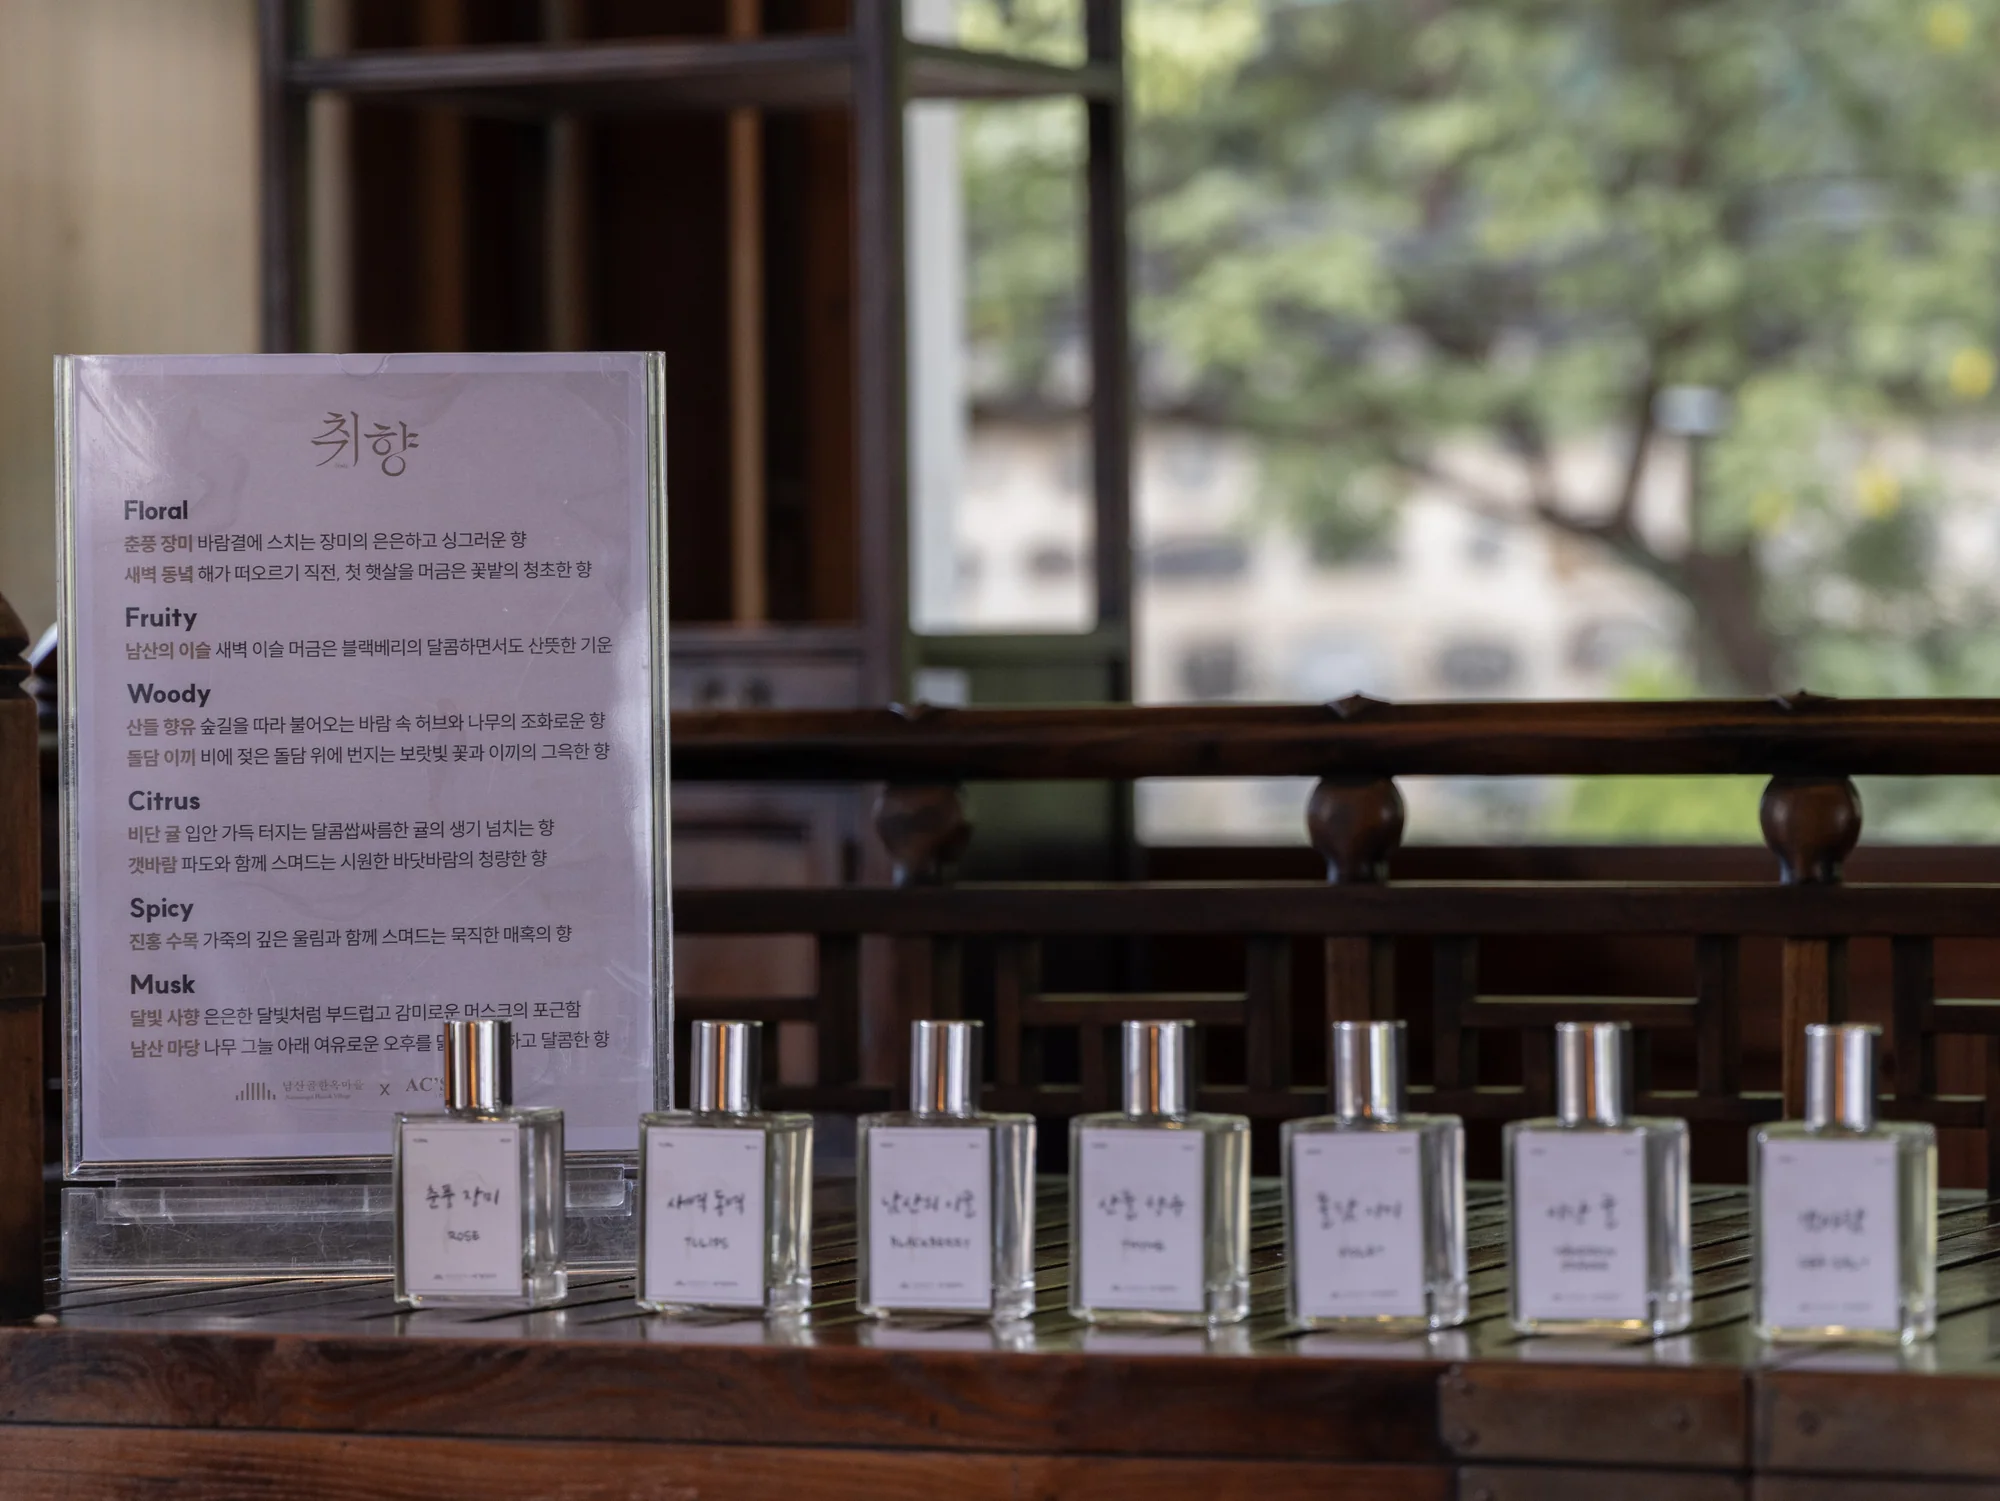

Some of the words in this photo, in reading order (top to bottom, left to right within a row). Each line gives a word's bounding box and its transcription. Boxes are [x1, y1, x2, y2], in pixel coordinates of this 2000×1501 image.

[311, 411, 419, 476] 취향
[124, 500, 188, 520] Floral
[124, 535, 157, 553] 춘풍
[161, 534, 193, 553] 장미
[198, 534, 262, 552] 바람결에
[267, 533, 316, 551] 스치는
[320, 532, 367, 551] 장미의
[372, 532, 437, 550] 은은하고
[442, 531, 507, 549] 싱그러운
[510, 531, 527, 548] 향
[124, 566, 156, 584] 새벽
[161, 565, 193, 583] 동녘
[198, 565, 231, 583] 해가
[235, 564, 299, 582] 떠오르기
[304, 564, 340, 582] 직전,
[345, 563, 361, 581] 첫
[365, 563, 414, 581] 햇살을
[419, 562, 467, 580] 머금은
[471, 562, 518, 579] 꽃밭의
[524, 561, 572, 579] 청초한
[576, 560, 592, 578] 향
[126, 607, 198, 632] Fruity
[126, 642, 174, 660] 남산의
[179, 641, 211, 659] 이슬
[216, 641, 247, 659] 새벽
[253, 640, 284, 658] 이슬
[289, 640, 338, 658] 머금은
[342, 638, 421, 657] 블랙베리의
[427, 637, 524, 656] 달콤하면서도
[528, 637, 577, 654] 산뜻한
[581, 636, 612, 654] 기운
[127, 683, 211, 708] Woody
[127, 718, 159, 736] 산들
[163, 718, 196, 736] 향유
[200, 717, 249, 735] 숲길을
[253, 716, 287, 734] 따라
[289, 716, 356, 734] 불어오는
[359, 715, 392, 732] 바람
[395, 715, 411, 732] 속
[415, 714, 464, 732] 허브와
[469, 713, 515, 731] 나무의
[521, 712, 585, 730] 조화로운
[589, 712, 606, 729] 향
[127, 749, 160, 767] 돌담
[164, 748, 195, 767] 이끼
[201, 748, 232, 766] 비에
[237, 748, 270, 765] 젖은
[273, 747, 307, 765] 돌담
[310, 746, 342, 764] 위에
[347, 746, 396, 763] 번지는
[400, 744, 448, 763] 보랏빛
[452, 744, 485, 762] 꽃과
[489, 743, 536, 761] 이끼의
[541, 743, 590, 760] 그윽한
[594, 742, 610, 760] 향
[128, 790, 200, 811] Citrus
[128, 825, 161, 843] 비단
[164, 826, 182, 843] 귤
[185, 824, 218, 842] 입안
[222, 824, 254, 842] 가득
[259, 823, 307, 841] 터지는
[312, 821, 409, 840] 달콤쌉싸름한
[413, 820, 444, 838] 귤의
[450, 820, 480, 838] 생기
[486, 819, 534, 837] 넘치는
[538, 817, 555, 836] 향
[128, 856, 178, 874] 갯바람
[181, 855, 231, 873] 파도와
[234, 854, 266, 872] 함께
[271, 854, 336, 871] 스며드는
[341, 852, 389, 871] 시원한
[394, 851, 473, 869] 바닷바람의
[479, 850, 527, 868] 청량한
[531, 849, 547, 867] 향
[130, 897, 194, 923] Spicy
[129, 933, 162, 951] 진홍
[166, 932, 199, 950] 수목
[203, 931, 250, 949] 가죽의
[256, 930, 288, 948] 깊은
[292, 929, 342, 947] 울림과
[345, 928, 377, 946] 함께
[382, 928, 447, 945] 스며드는
[451, 926, 500, 945] 묵직한
[504, 925, 550, 943] 매혹의
[556, 925, 572, 942] 향
[131, 974, 195, 994] Musk
[131, 1009, 162, 1027] 달빛
[167, 1008, 200, 1027] 사향
[204, 1007, 253, 1025] 은은한
[257, 1006, 321, 1024] 달빛처럼
[326, 1005, 391, 1023] 부드럽고
[395, 1003, 460, 1022] 감미로운
[465, 1002, 527, 1019] 머스크의
[533, 1000, 581, 1018] 포근함
[131, 1040, 164, 1058] 남산
[168, 1039, 200, 1057] 마당
[205, 1039, 237, 1056] 나무
[241, 1038, 273, 1055] 그늘
[278, 1037, 309, 1054] 아래
[314, 1036, 379, 1054] 여유로운
[383, 1034, 432, 1052] 오후를
[511, 1032, 536, 1050] 하고
[542, 1031, 590, 1049] 달콤한
[593, 1030, 610, 1048] 향
[405, 1077, 445, 1091] AC'S
[462, 1186, 500, 1208] 장미
[447, 1230, 480, 1242] ROSE
